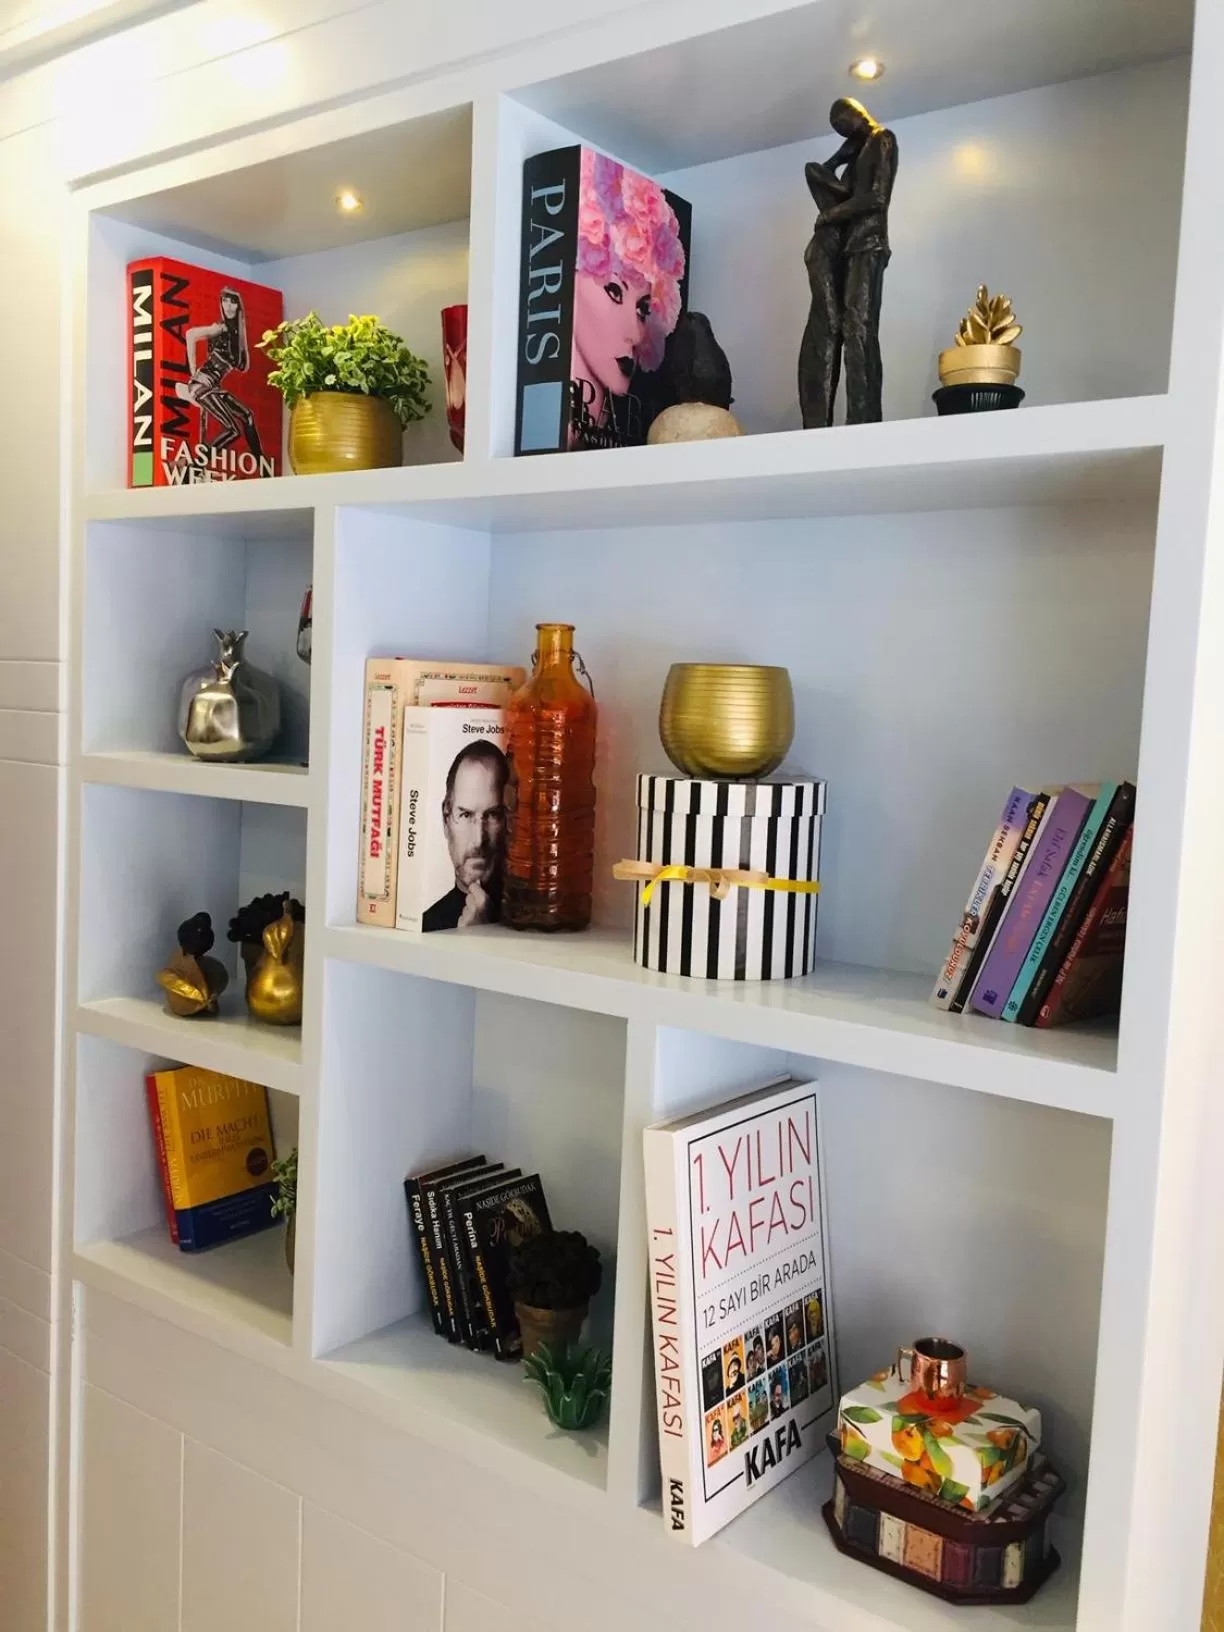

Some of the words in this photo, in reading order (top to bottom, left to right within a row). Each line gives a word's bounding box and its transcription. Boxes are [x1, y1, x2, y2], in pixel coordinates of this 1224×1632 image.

[524, 178, 565, 365] PARIS
[132, 285, 153, 446] MILAN
[160, 271, 192, 437] MILAN
[160, 437, 276, 478] FASHION
[372, 726, 387, 773] TÜRK
[462, 724, 485, 734] Steve
[486, 724, 505, 735] Jobs
[369, 779, 386, 859] MUTFAĞI
[409, 790, 419, 827] Steve
[1007, 797, 1021, 823] KAAN
[407, 827, 416, 858] Jobs
[693, 1153, 711, 1214] 1.
[718, 1110, 811, 1200] YILIN
[411, 1194, 425, 1232] Feraye
[464, 1211, 478, 1249] Perina
[653, 1227, 674, 1241] 1.
[701, 1175, 814, 1279] KAFASI
[655, 1253, 678, 1325] YILIN
[702, 1305, 715, 1329] 12
[719, 1290, 748, 1321] SAYI
[750, 1271, 771, 1302] BİR
[773, 1250, 817, 1294] ARADA
[723, 1340, 740, 1354] KAFA
[658, 1333, 683, 1438] KAFASI
[744, 1419, 803, 1487] KAFA
[669, 1477, 685, 1530] KAFA
